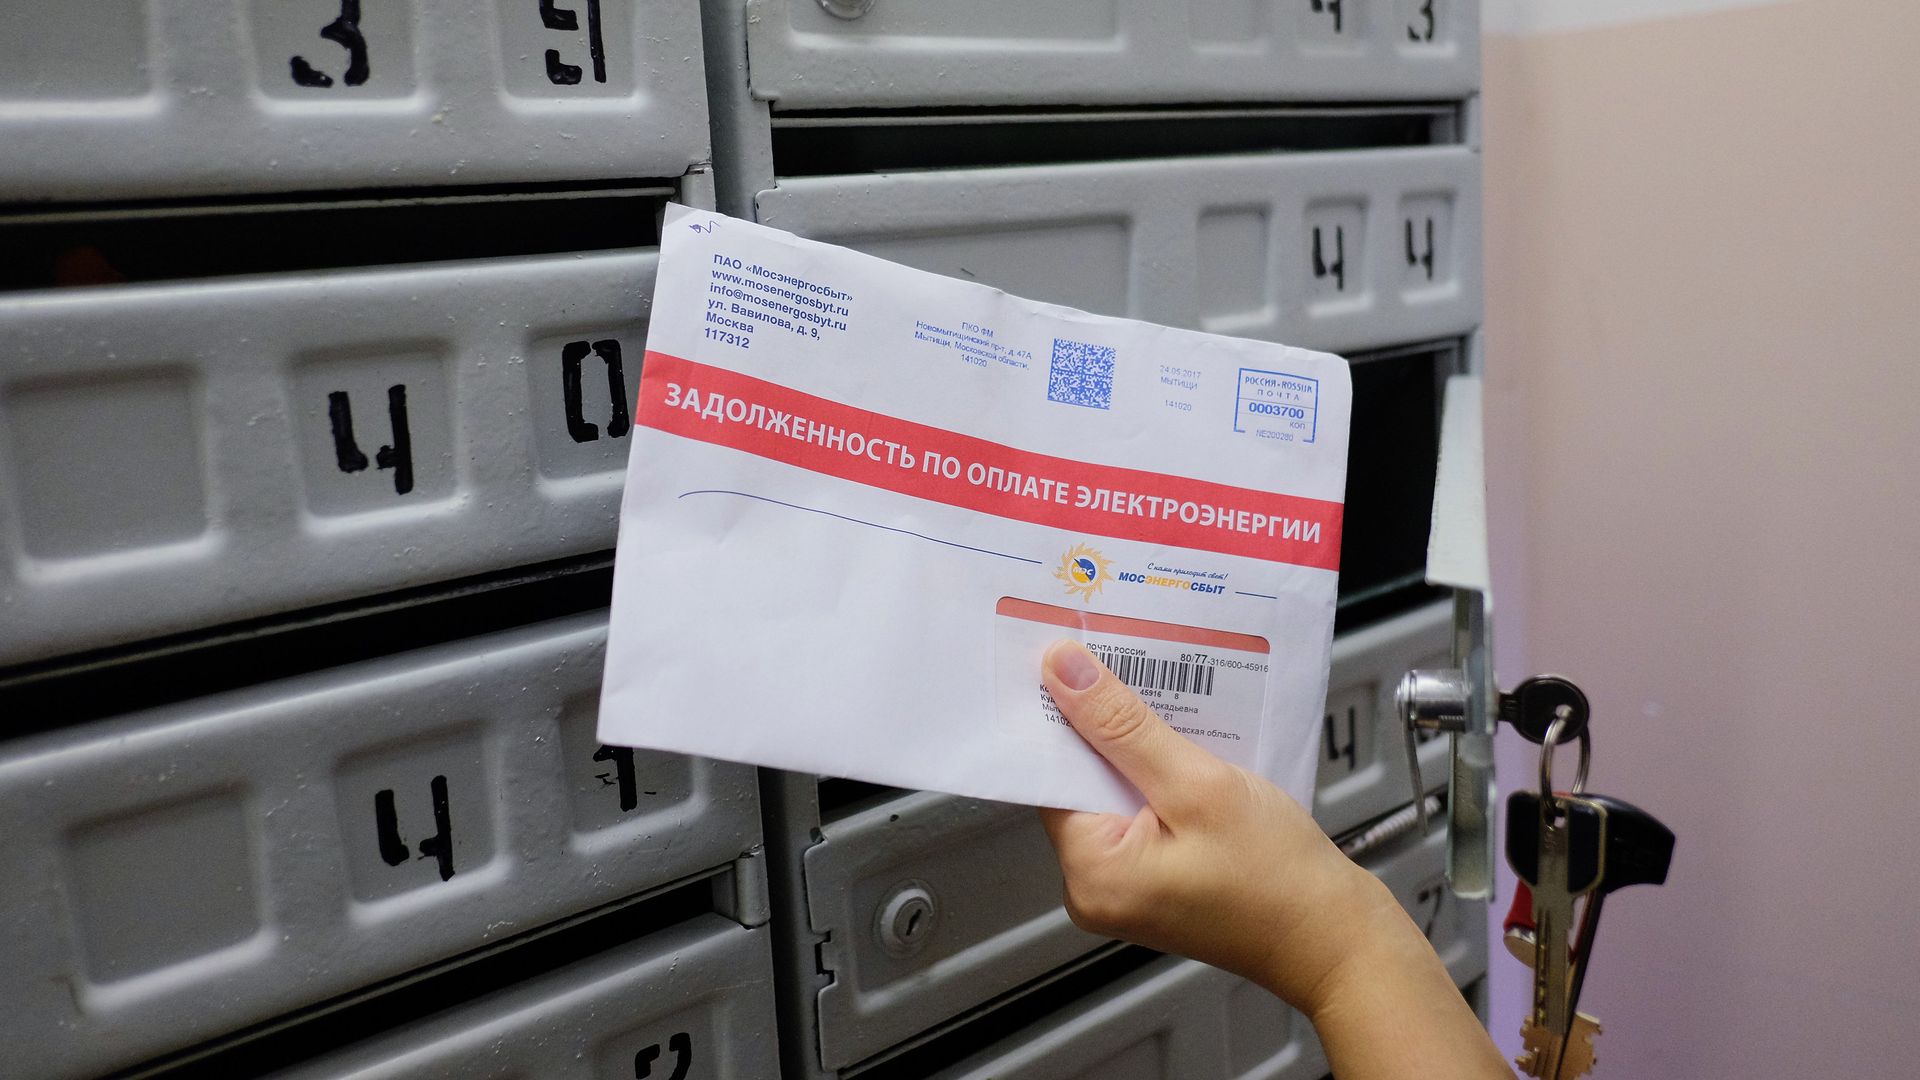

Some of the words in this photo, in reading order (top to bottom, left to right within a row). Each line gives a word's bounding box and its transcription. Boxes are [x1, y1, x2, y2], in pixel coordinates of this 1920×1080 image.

[1312, 225, 1344, 291] 4
[1405, 218, 1433, 280] 4
[713, 254, 742, 270] ПАО
[746, 264, 853, 301] «Мосэнергосбыт»
[712, 270, 849, 316] www.mosenergosbyt.ru
[710, 282, 847, 331] info@mosenergosbyt.ru
[706, 311, 754, 333] Москва
[708, 298, 727, 311] ул.
[731, 303, 794, 332] Вавилова,
[797, 324, 808, 336] д.
[811, 328, 820, 340] 9,
[961, 321, 980, 334] ПКО
[704, 327, 750, 349] 117312
[954, 341, 997, 360] Московской
[961, 354, 988, 368] 141020
[1165, 399, 1192, 412] 141020
[1248, 402, 1304, 420] 0003700
[328, 384, 413, 495] 4
[562, 339, 631, 443] 0
[664, 382, 916, 469] ЗАДОЛЖЕННОСТЬ
[922, 450, 961, 479] ПО
[967, 462, 1069, 505] ОПЛАТЕ
[1074, 485, 1321, 544] ЭЛЕКТРОЭНЕРГИИ
[1118, 571, 1226, 595] МОСЭНЕРГОСБЫТ
[1086, 642, 1112, 652] ПОЧТА
[1114, 646, 1146, 656] РОССИИ
[1139, 689, 1162, 698] 45916
[1149, 701, 1199, 714] Аркадьевна
[1163, 713, 1174, 721] 61
[1206, 729, 1241, 741] область
[375, 775, 456, 882] 4
